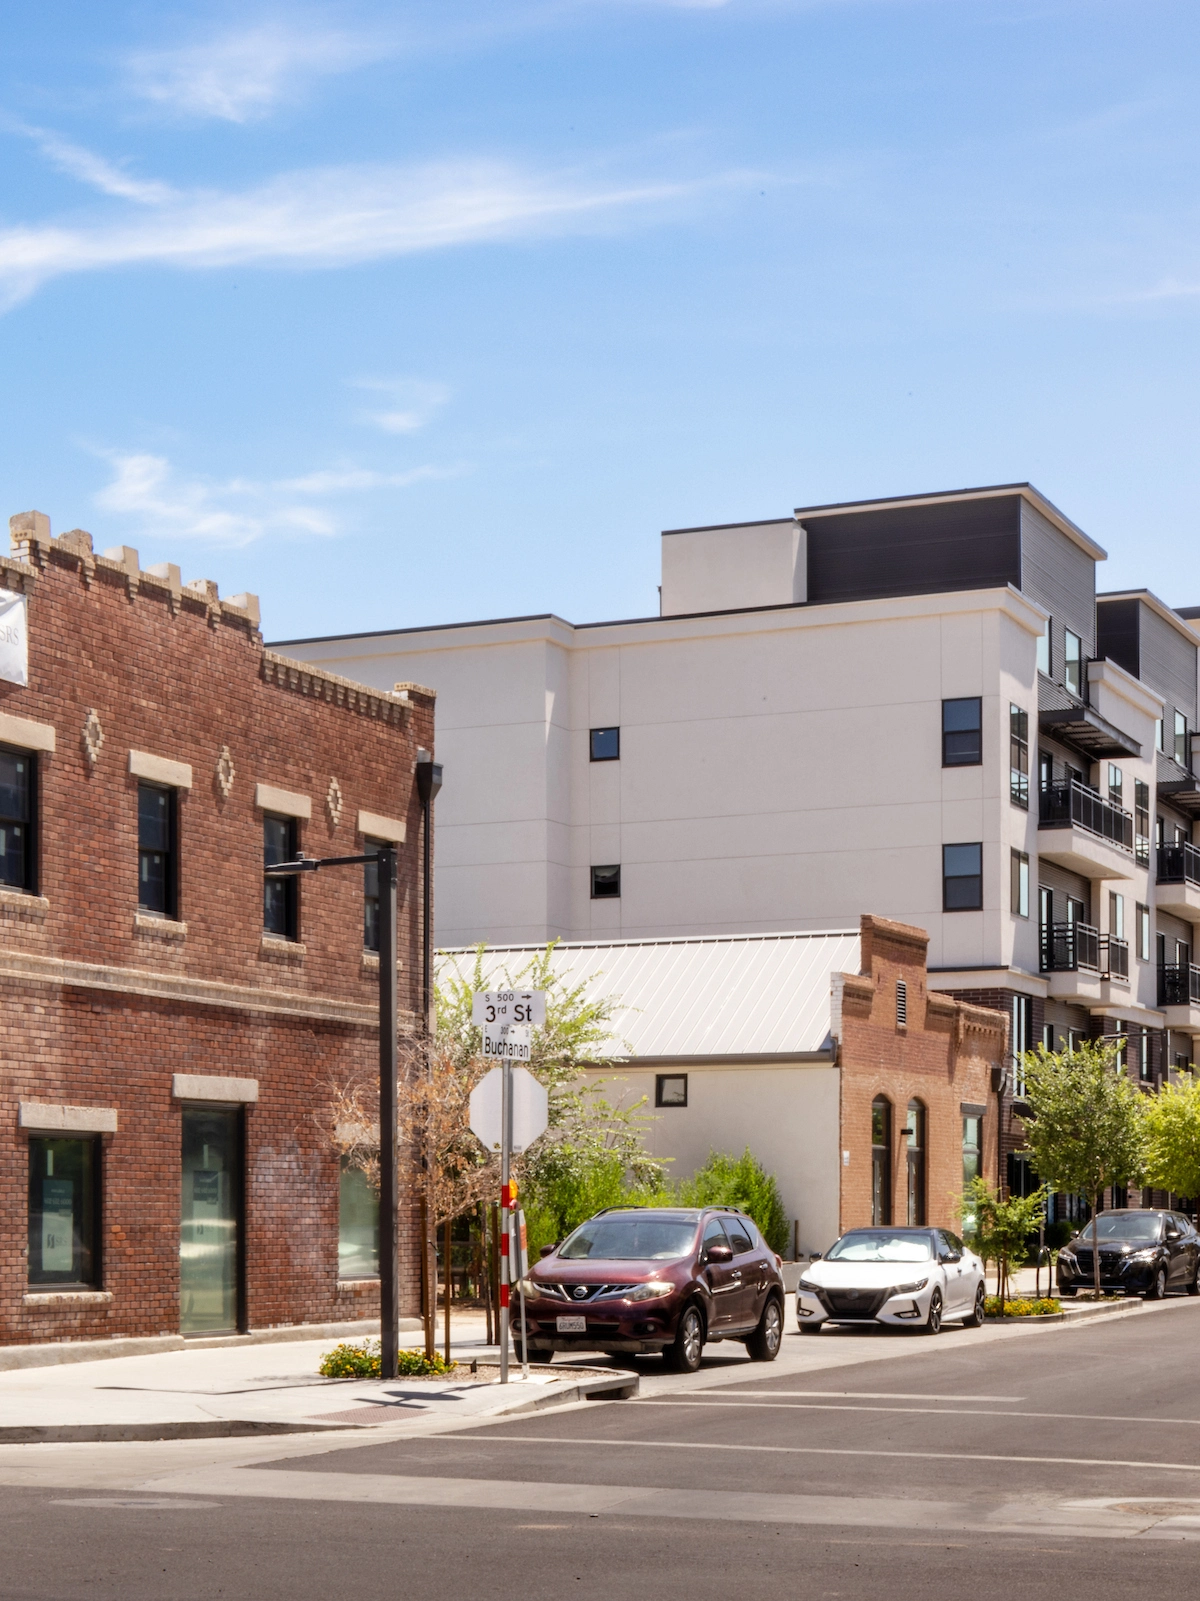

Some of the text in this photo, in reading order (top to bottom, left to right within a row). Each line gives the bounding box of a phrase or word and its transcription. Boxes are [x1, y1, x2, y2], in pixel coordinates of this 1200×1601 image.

[485, 993, 514, 1002] S 500
[485, 1004, 532, 1023] 3rd St
[484, 1036, 529, 1058] Buchanan
